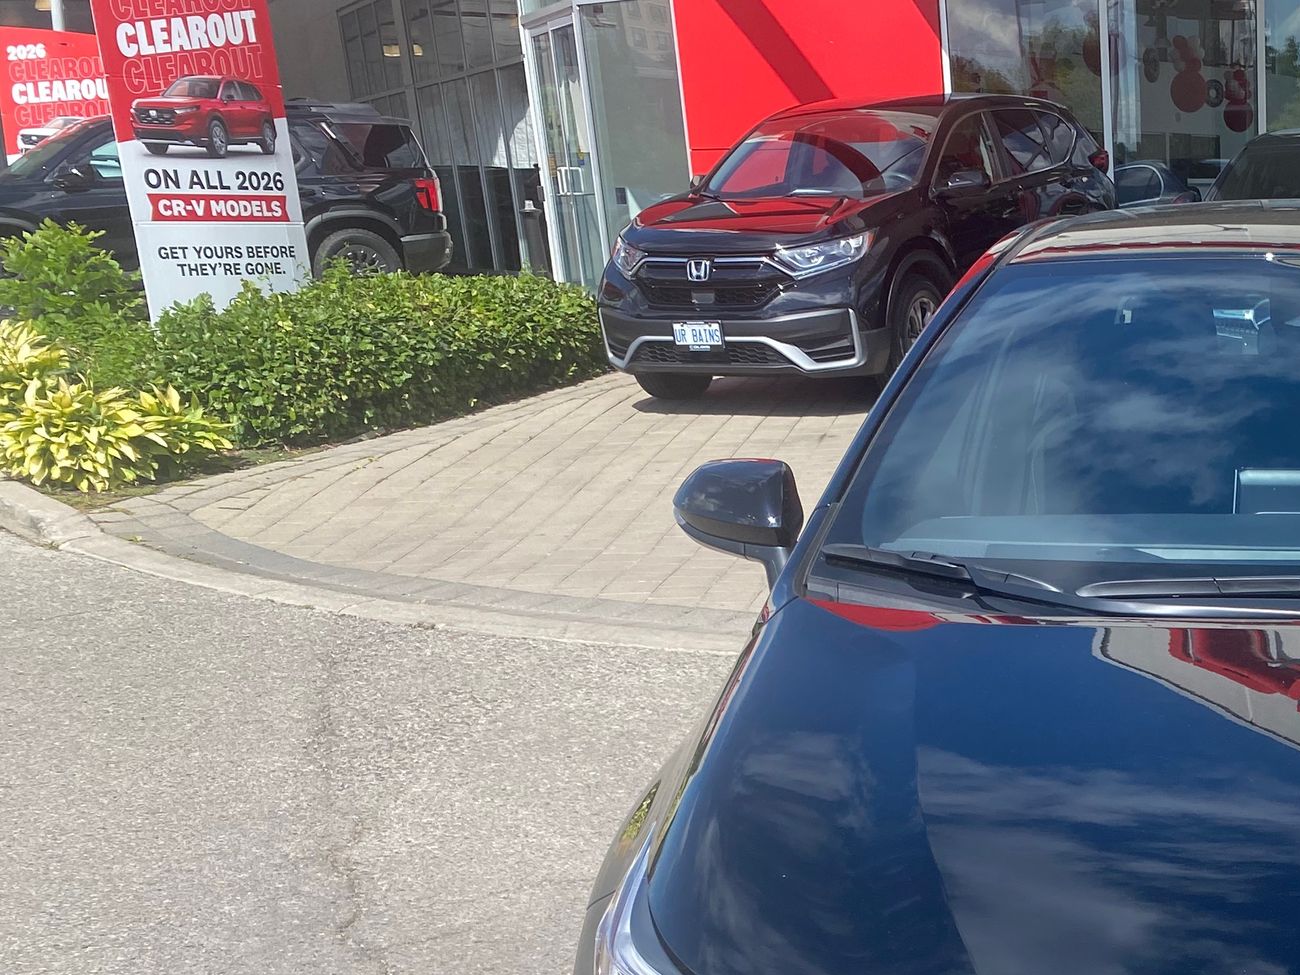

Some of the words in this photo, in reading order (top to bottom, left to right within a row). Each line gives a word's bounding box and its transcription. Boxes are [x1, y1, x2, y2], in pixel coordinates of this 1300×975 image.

[116, 10, 256, 57] CLEAROUT
[6, 43, 47, 61] 2026
[9, 57, 105, 82] CLEAROU
[12, 79, 109, 104] CLEAROU
[144, 169, 180, 189] ON
[189, 170, 231, 190] ALL
[235, 171, 285, 191] 2026
[158, 199, 205, 217] CR-V
[210, 200, 282, 217] MODELS
[158, 246, 188, 260] GET
[192, 246, 243, 259] YOURS
[246, 245, 296, 258] BEFORE
[177, 262, 242, 276] THEY’RE
[245, 262, 286, 275] GONE.
[675, 329, 687, 343] UR
[692, 329, 720, 343] BAINS
